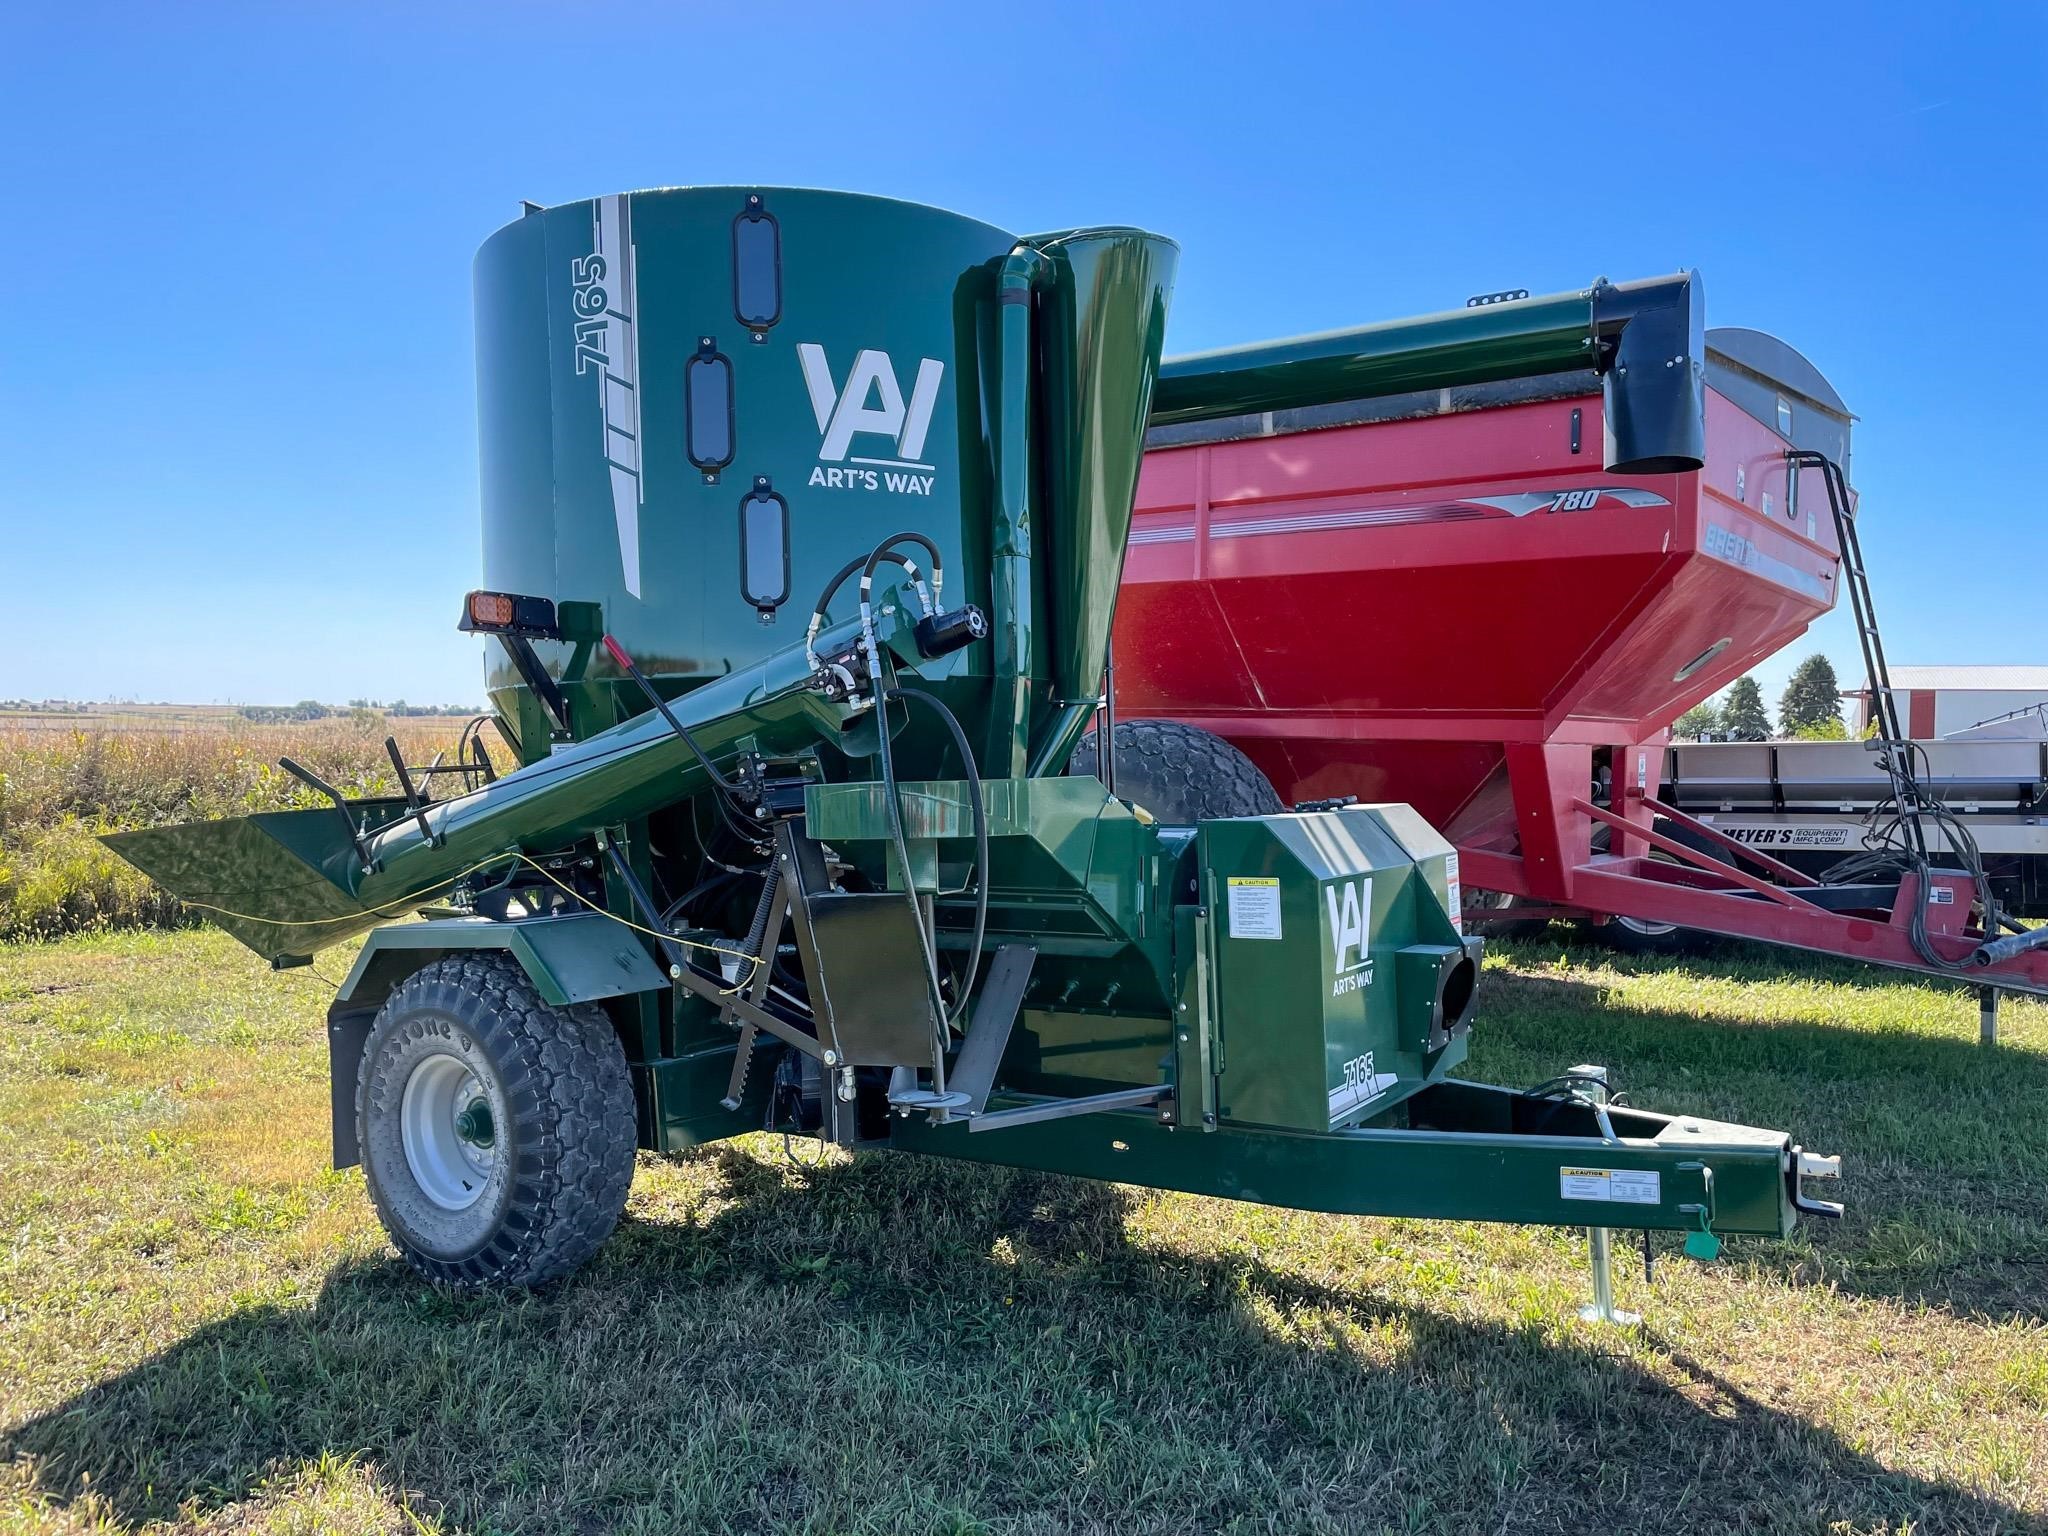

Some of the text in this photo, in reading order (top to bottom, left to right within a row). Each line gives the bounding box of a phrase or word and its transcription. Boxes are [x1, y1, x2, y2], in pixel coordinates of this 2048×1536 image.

[571, 254, 610, 375] 7165
[808, 466, 935, 496] ART'S WAY
[1547, 489, 1601, 514] 780
[1797, 829, 1847, 837] EQUIPMENT
[1333, 969, 1374, 997] ART'S WAY
[1343, 1051, 1375, 1092] 7165
